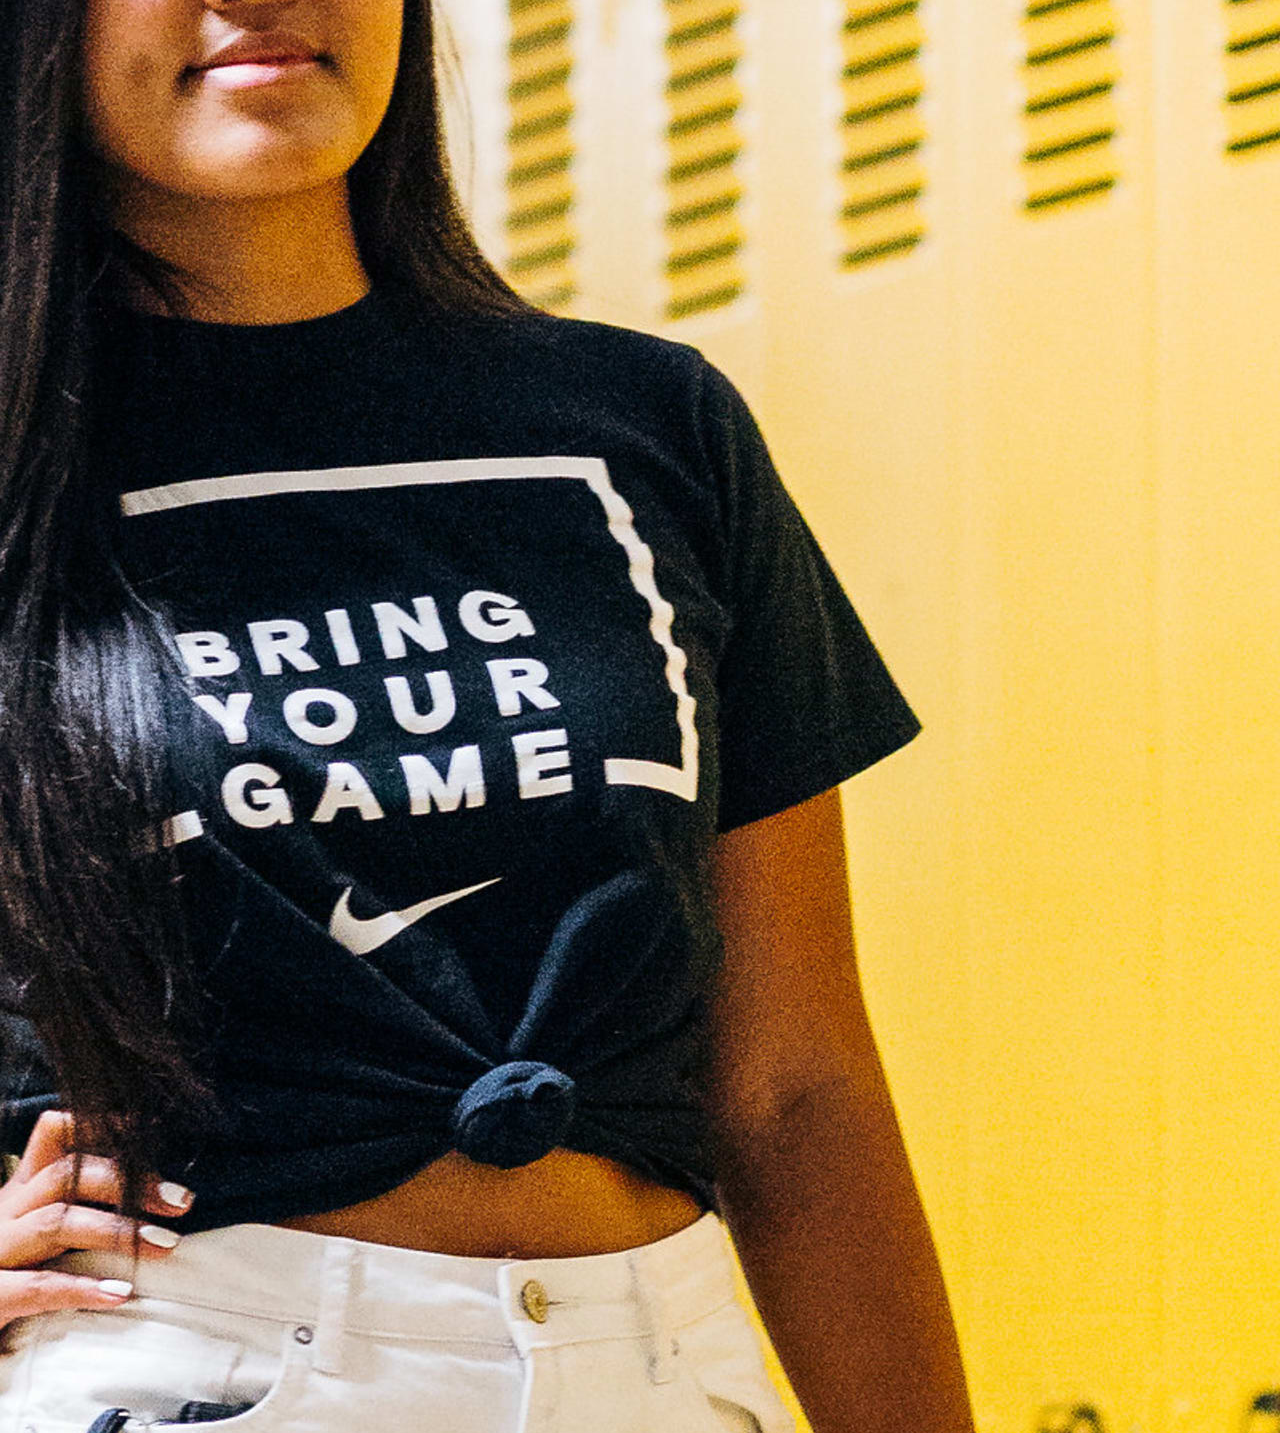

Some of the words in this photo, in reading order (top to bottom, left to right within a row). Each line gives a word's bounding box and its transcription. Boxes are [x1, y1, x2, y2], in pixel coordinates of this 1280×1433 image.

[174, 589, 536, 678] BRING
[191, 657, 561, 746] YOUR
[221, 728, 574, 829] GAME
